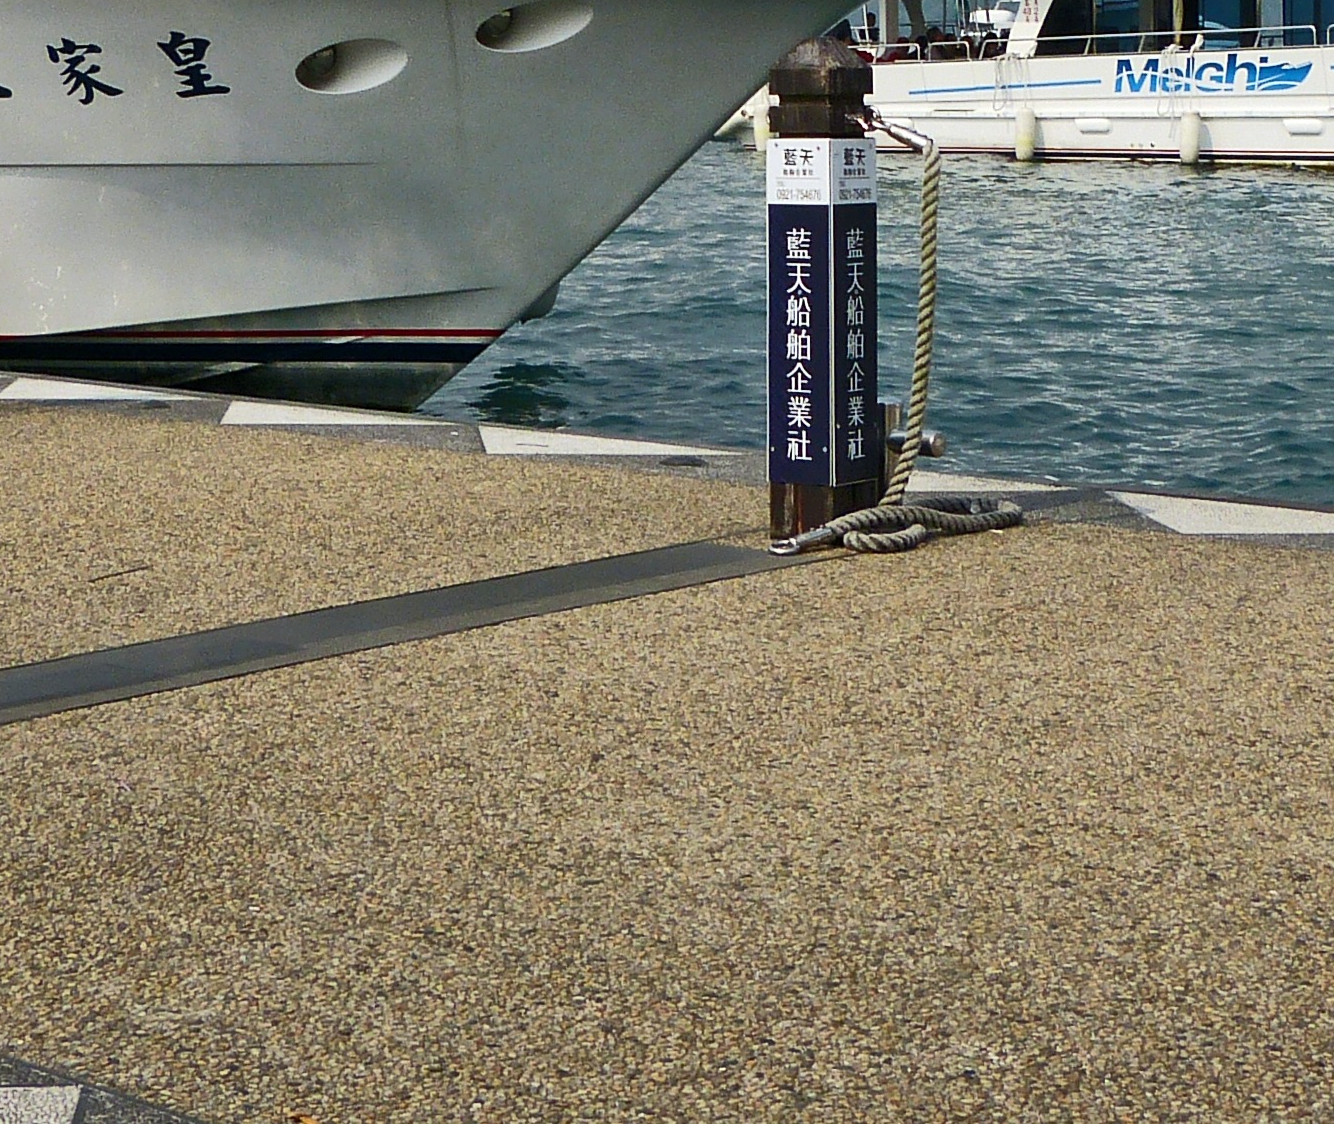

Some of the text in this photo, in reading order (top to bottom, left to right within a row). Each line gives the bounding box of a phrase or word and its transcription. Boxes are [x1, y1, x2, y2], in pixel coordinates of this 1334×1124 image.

[783, 148, 814, 166] 藍天
[843, 147, 866, 166] 藍天
[785, 228, 813, 461] 藍天船舶企業社
[846, 228, 866, 461] 藍天船舶企業社
